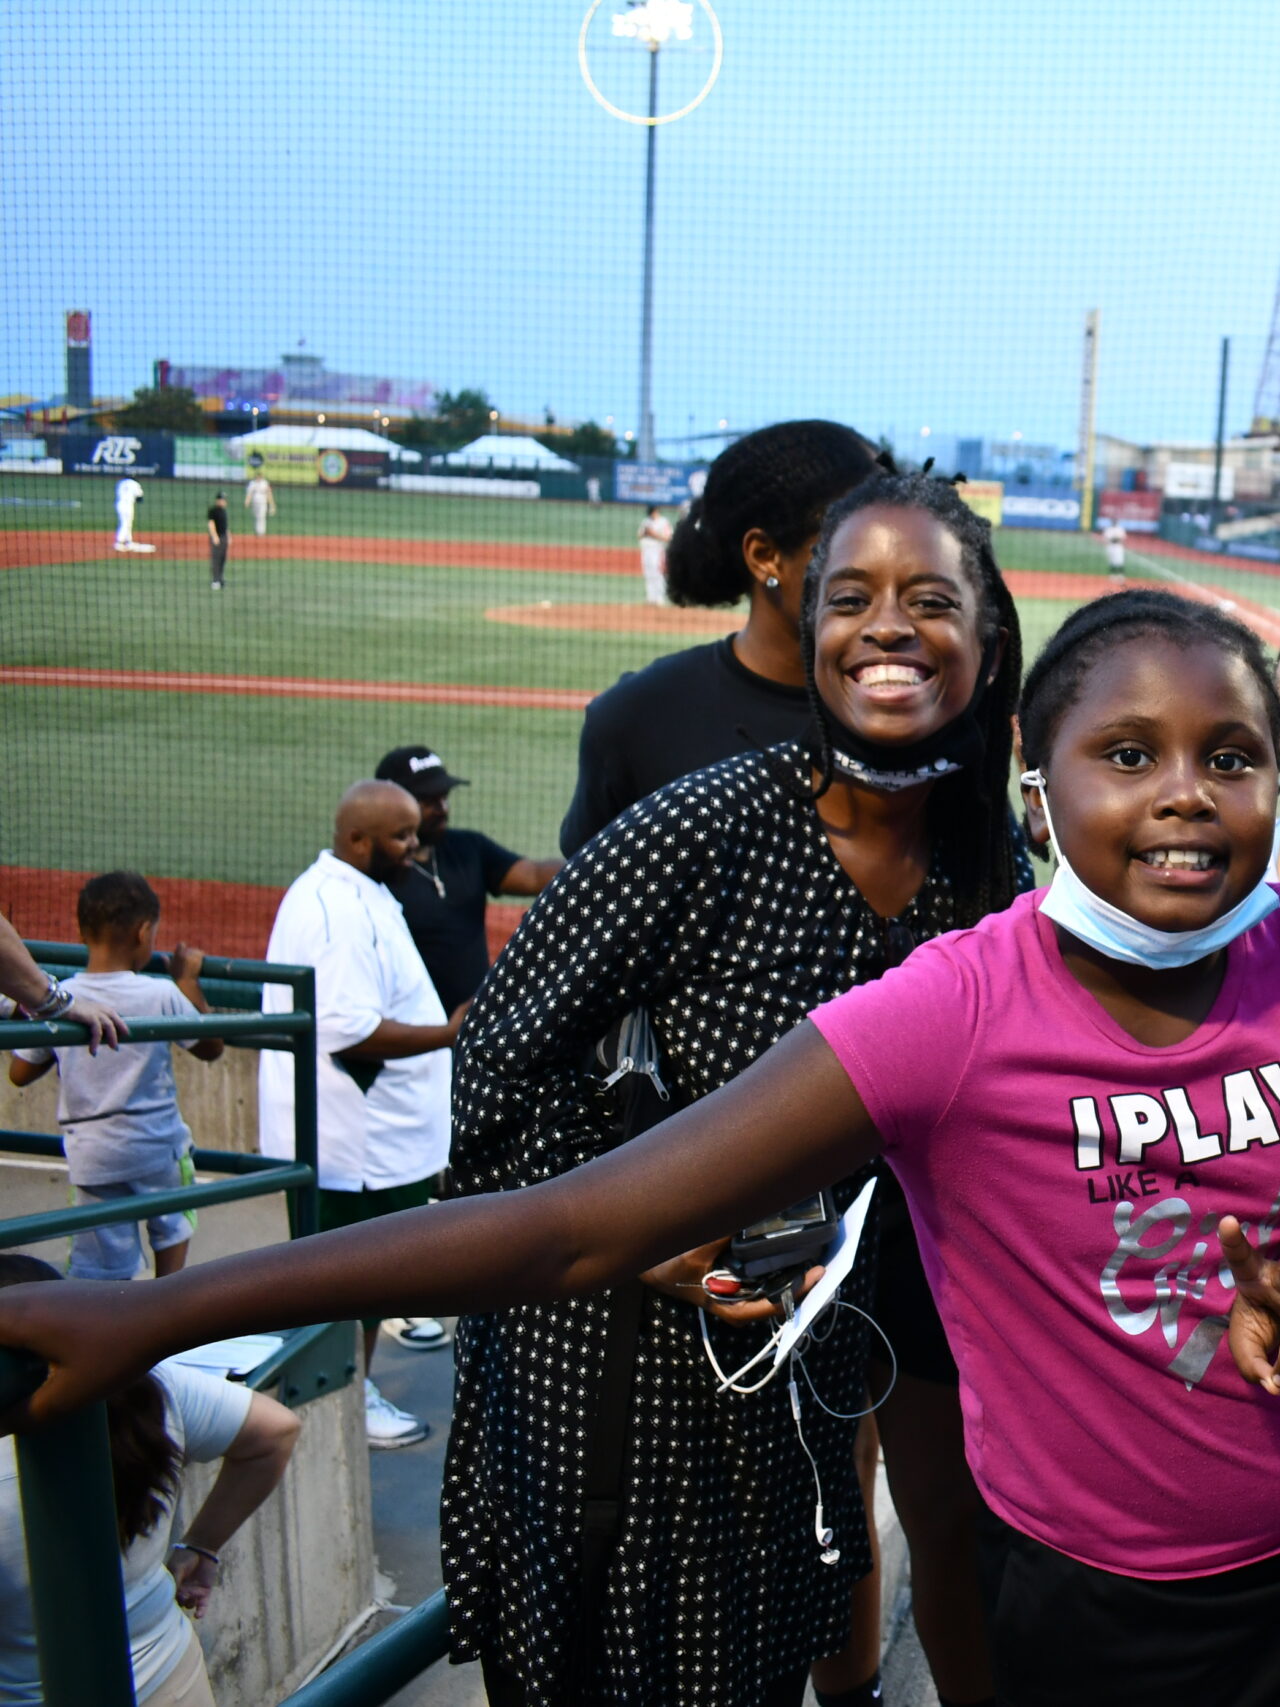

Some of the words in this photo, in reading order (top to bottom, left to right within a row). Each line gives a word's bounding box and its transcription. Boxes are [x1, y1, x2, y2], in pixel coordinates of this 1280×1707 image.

[1070, 1096, 1103, 1171] I
[1087, 1170, 1160, 1205] LIKE
[1174, 1171, 1200, 1190] A
